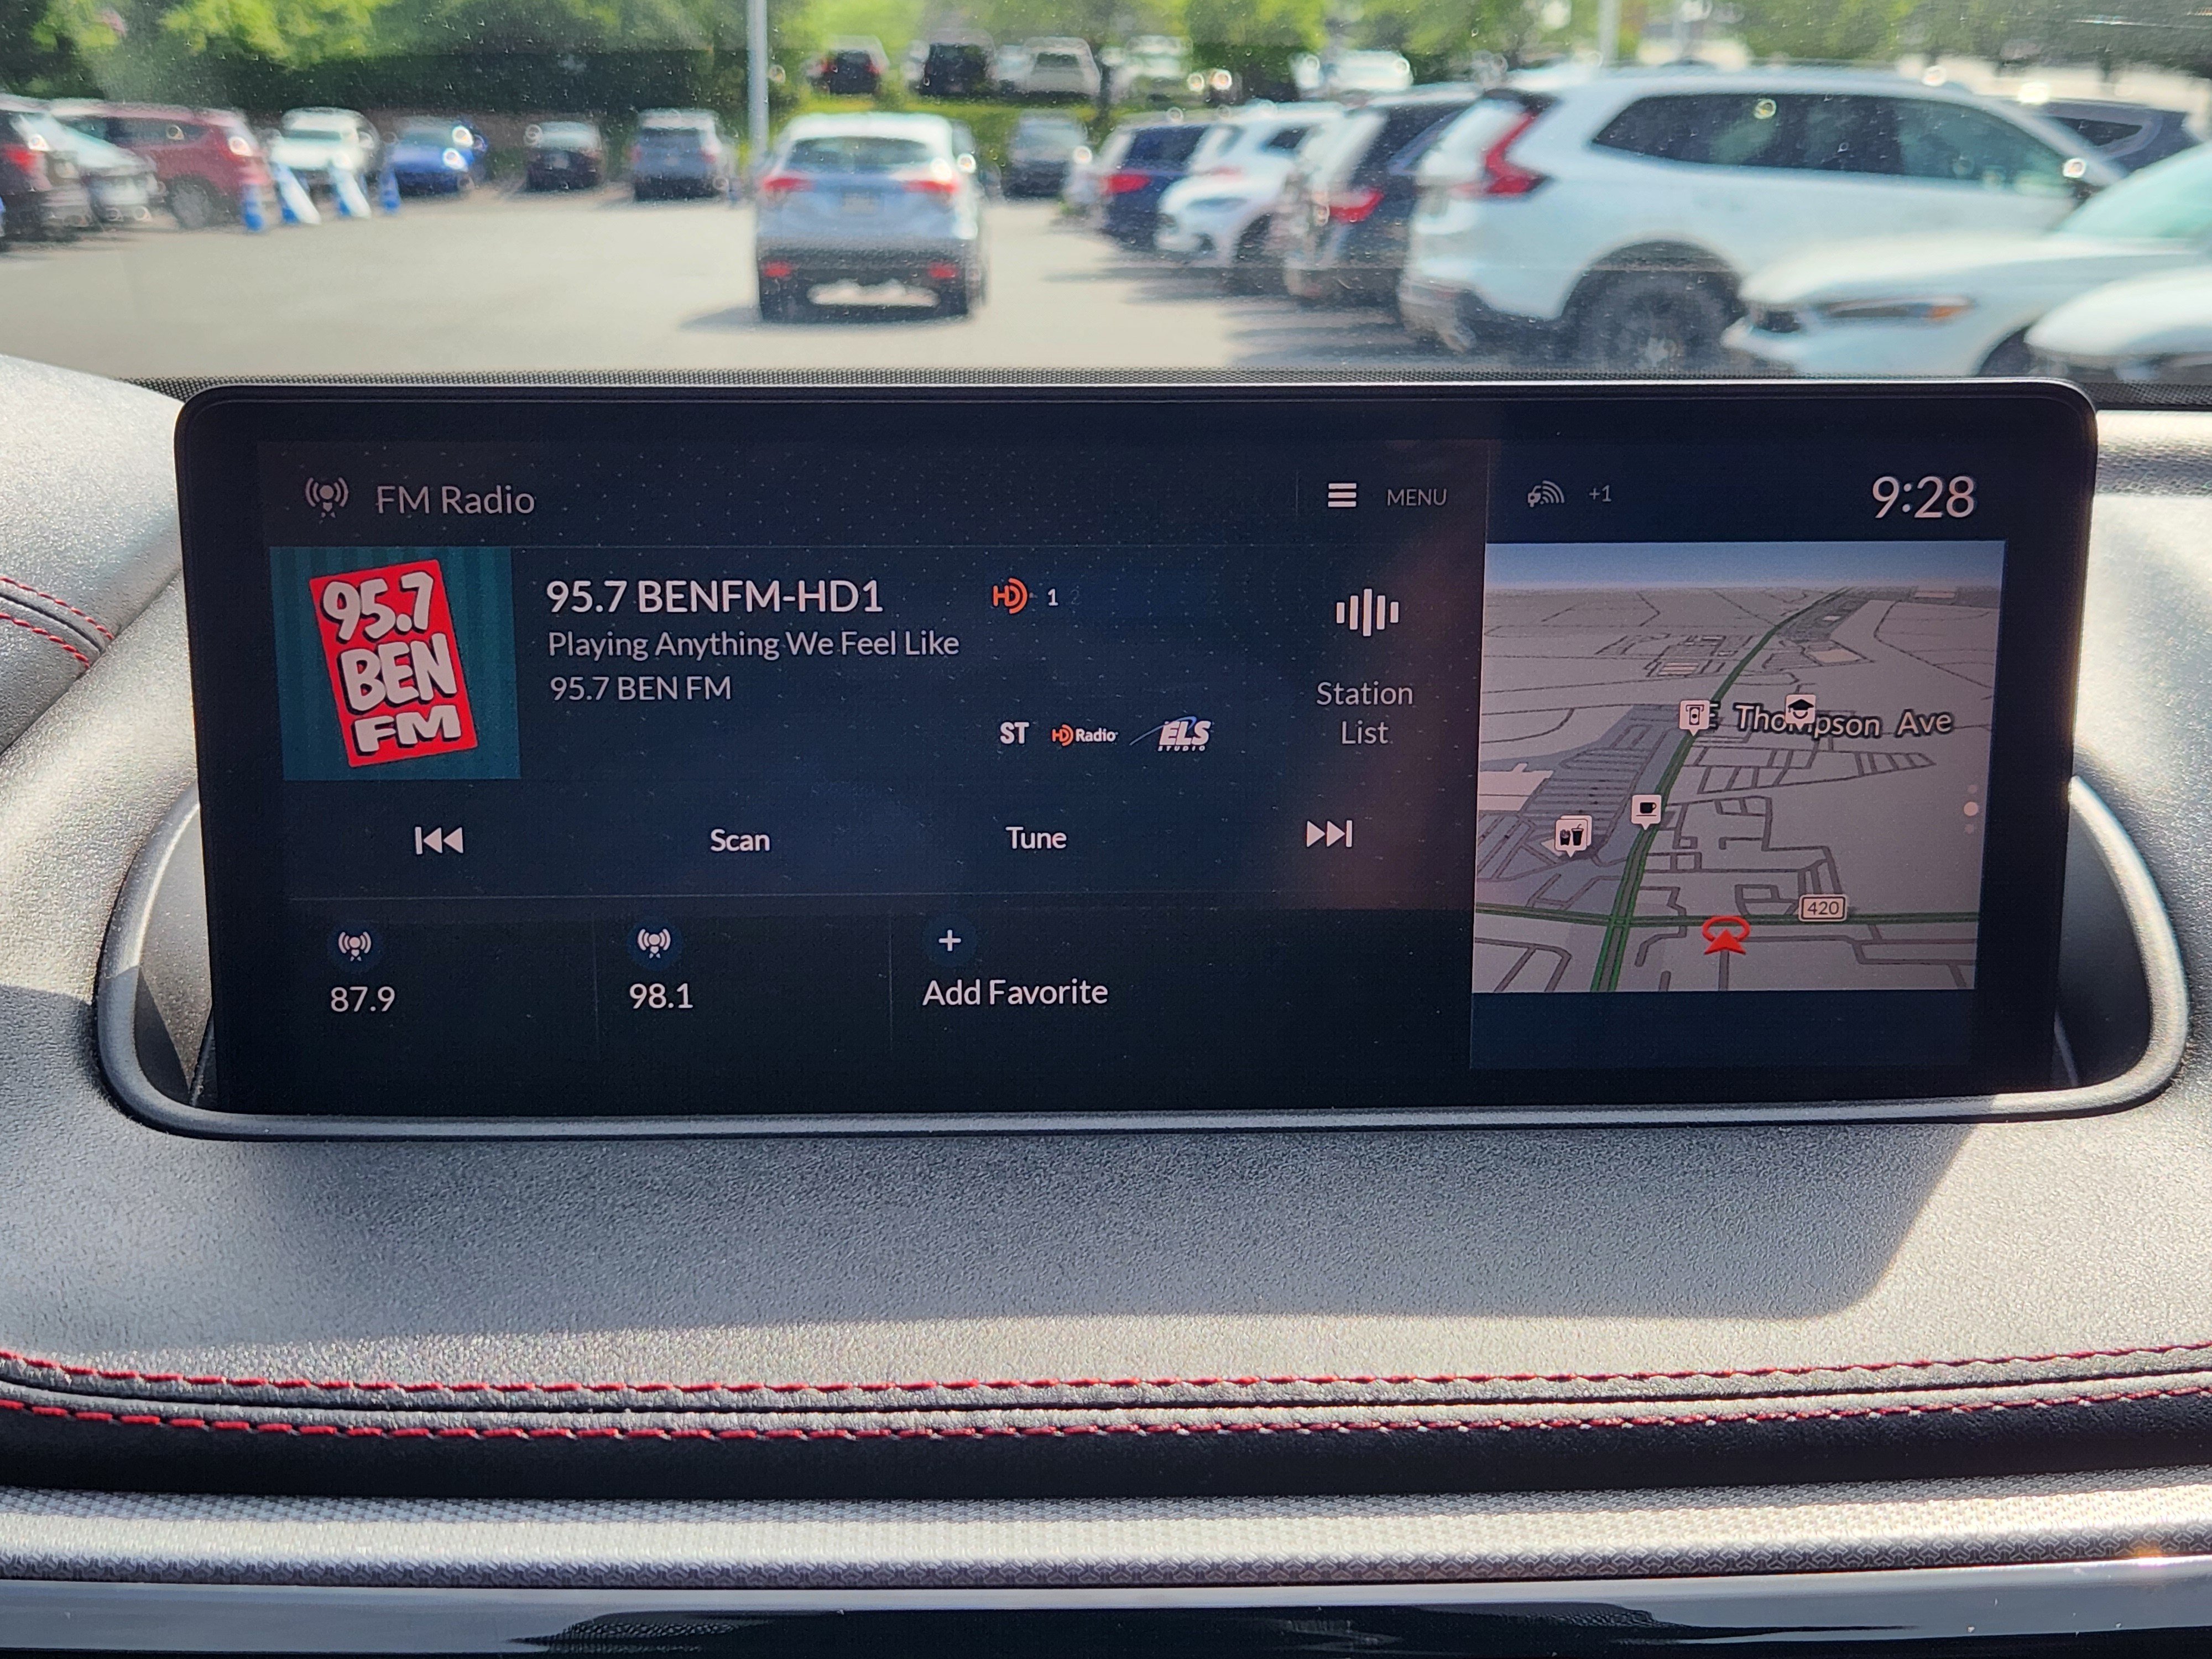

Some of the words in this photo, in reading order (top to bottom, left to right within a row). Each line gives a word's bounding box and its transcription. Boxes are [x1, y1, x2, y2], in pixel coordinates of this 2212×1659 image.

[377, 486, 430, 514] FM
[441, 484, 535, 514] Radio
[1387, 488, 1447, 506] MENU
[1589, 484, 1611, 502] +1
[1872, 476, 1974, 518] 9:28
[322, 571, 434, 640] 95.7
[546, 580, 627, 613] 95.7
[638, 580, 883, 613] BENFM-HD1
[1048, 588, 1058, 606] 1
[549, 631, 649, 661] Playing
[655, 630, 780, 661] Anything
[785, 631, 834, 655] We
[842, 630, 896, 655] Feel
[905, 630, 959, 655] Like
[339, 633, 457, 712] BEN
[550, 676, 609, 701] 95.7
[618, 676, 678, 701] BEN
[687, 676, 731, 701] FM
[1316, 681, 1413, 705] Station
[354, 705, 461, 753] FM
[1000, 722, 1030, 744] ST
[1159, 721, 1212, 745] ELS
[1342, 720, 1389, 744] List
[1897, 711, 1952, 735] Ave
[711, 829, 770, 852] Scan
[1005, 826, 1067, 850] Tune
[1807, 901, 1839, 915] 420
[331, 986, 395, 1012] 87.9
[629, 983, 693, 1009] 98.1
[922, 979, 980, 1006] Add
[989, 978, 1108, 1005] Favorite
